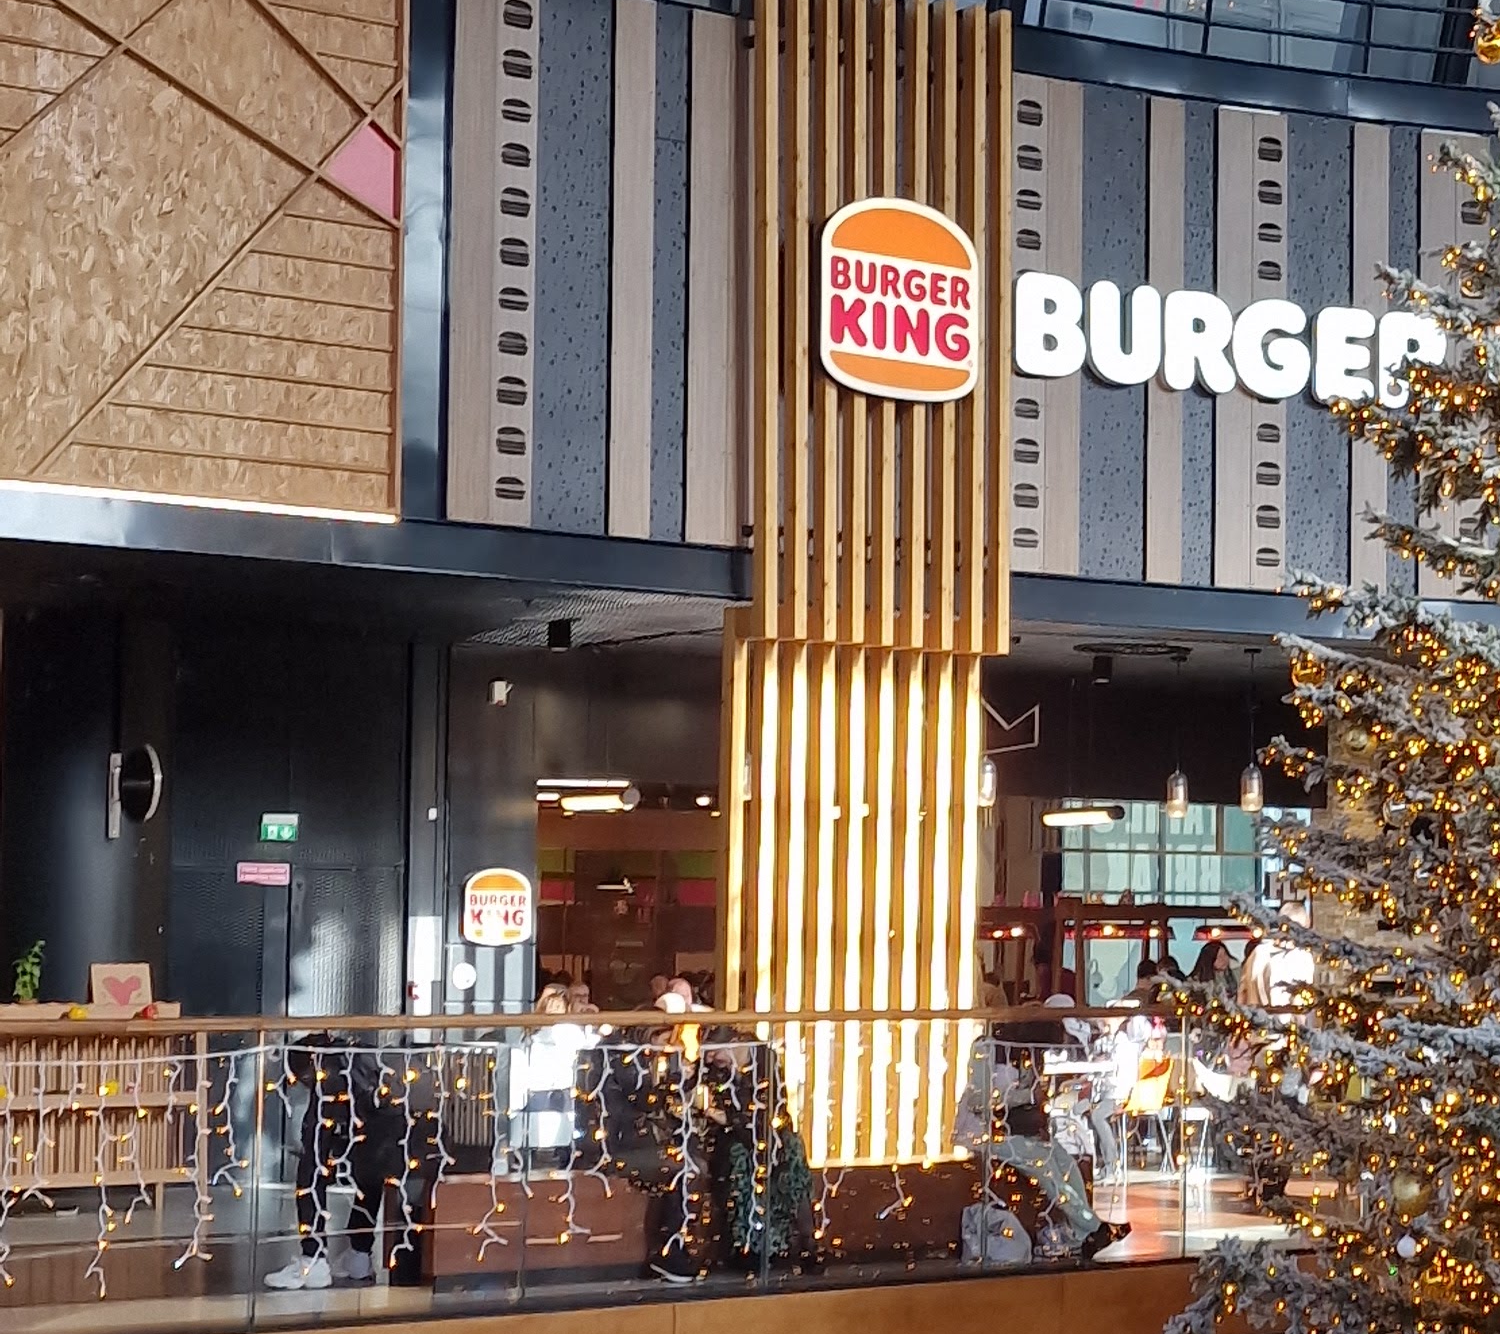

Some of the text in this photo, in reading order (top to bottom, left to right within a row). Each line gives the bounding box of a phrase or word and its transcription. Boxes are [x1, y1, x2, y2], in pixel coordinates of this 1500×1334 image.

[830, 255, 971, 310] BURGER
[830, 294, 971, 362] KING
[1014, 270, 1448, 410] BURGER
[469, 894, 527, 907] BURGER
[470, 909, 526, 926] KNG
